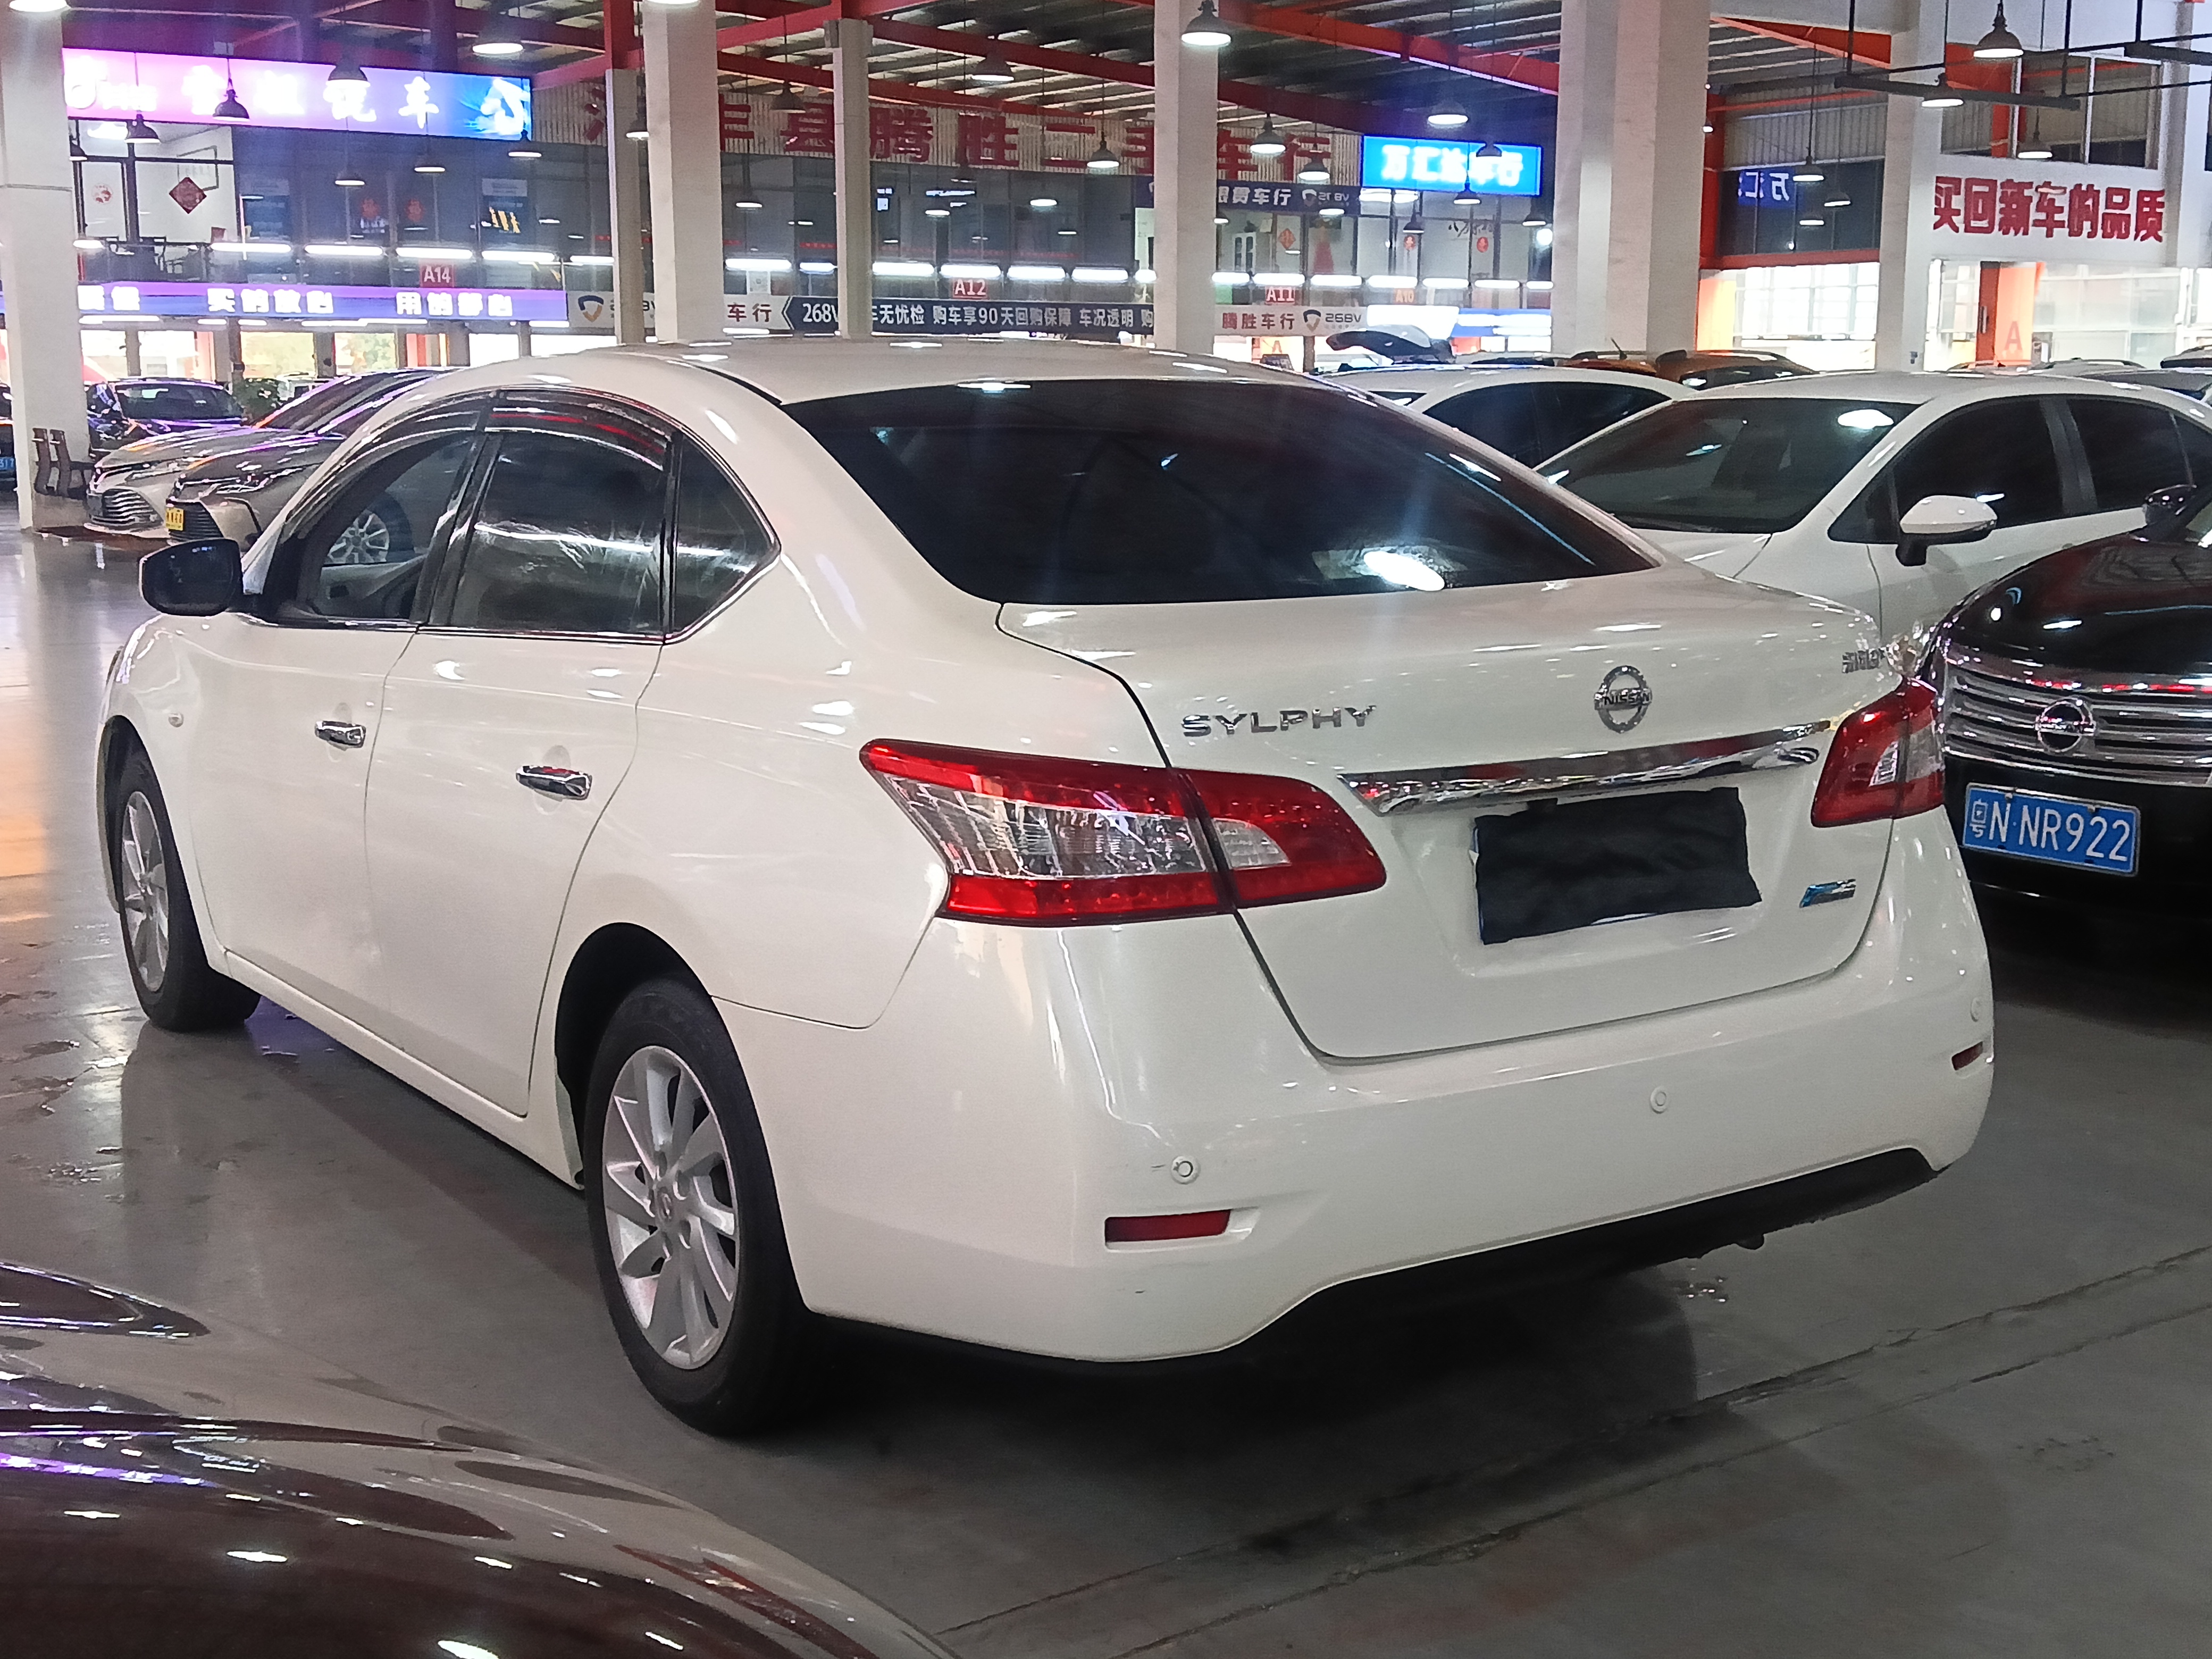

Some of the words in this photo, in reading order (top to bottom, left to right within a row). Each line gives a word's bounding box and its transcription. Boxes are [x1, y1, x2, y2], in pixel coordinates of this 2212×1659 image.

[1933, 176, 2165, 242] 买回新车的品质
[423, 266, 451, 283] A14
[955, 279, 987, 296] A12
[1266, 287, 1295, 302] A11
[727, 303, 772, 323] 车行
[933, 305, 1073, 327] 购车享90天回购保障
[1079, 308, 1134, 328] 车况透明
[1222, 312, 1295, 330] 腾胜车行
[1325, 313, 1362, 323] 268V
[1181, 705, 1377, 737] SYLPHY
